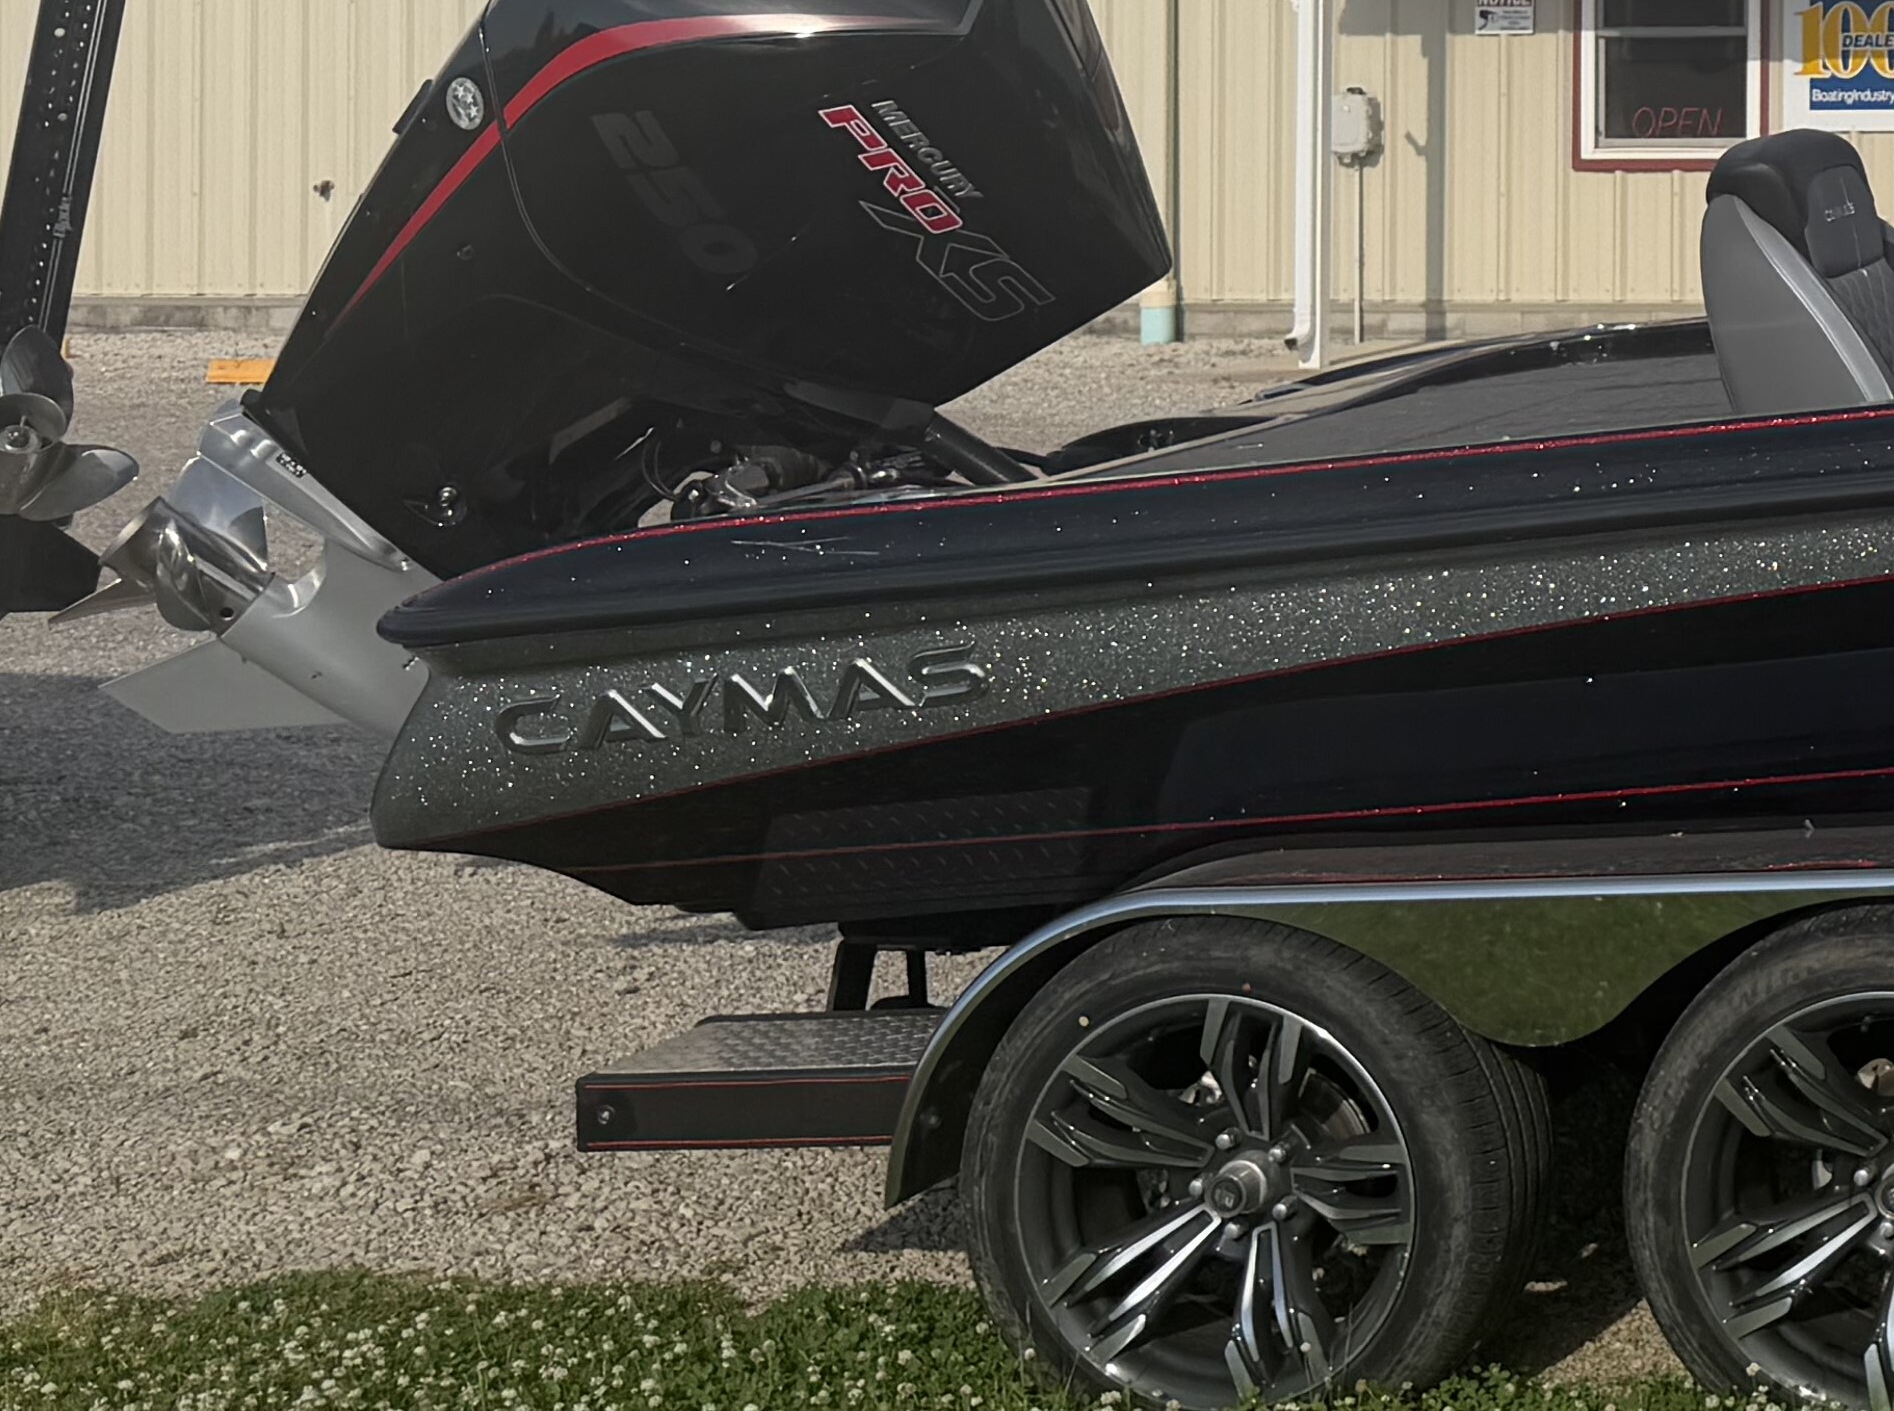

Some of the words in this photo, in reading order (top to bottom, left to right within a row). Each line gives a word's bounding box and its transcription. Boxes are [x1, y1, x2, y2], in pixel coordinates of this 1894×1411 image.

[818, 104, 963, 234] PRO
[871, 99, 984, 198] MERCURY
[1632, 106, 1723, 138] OPEN
[498, 641, 990, 753] CAYMAS
